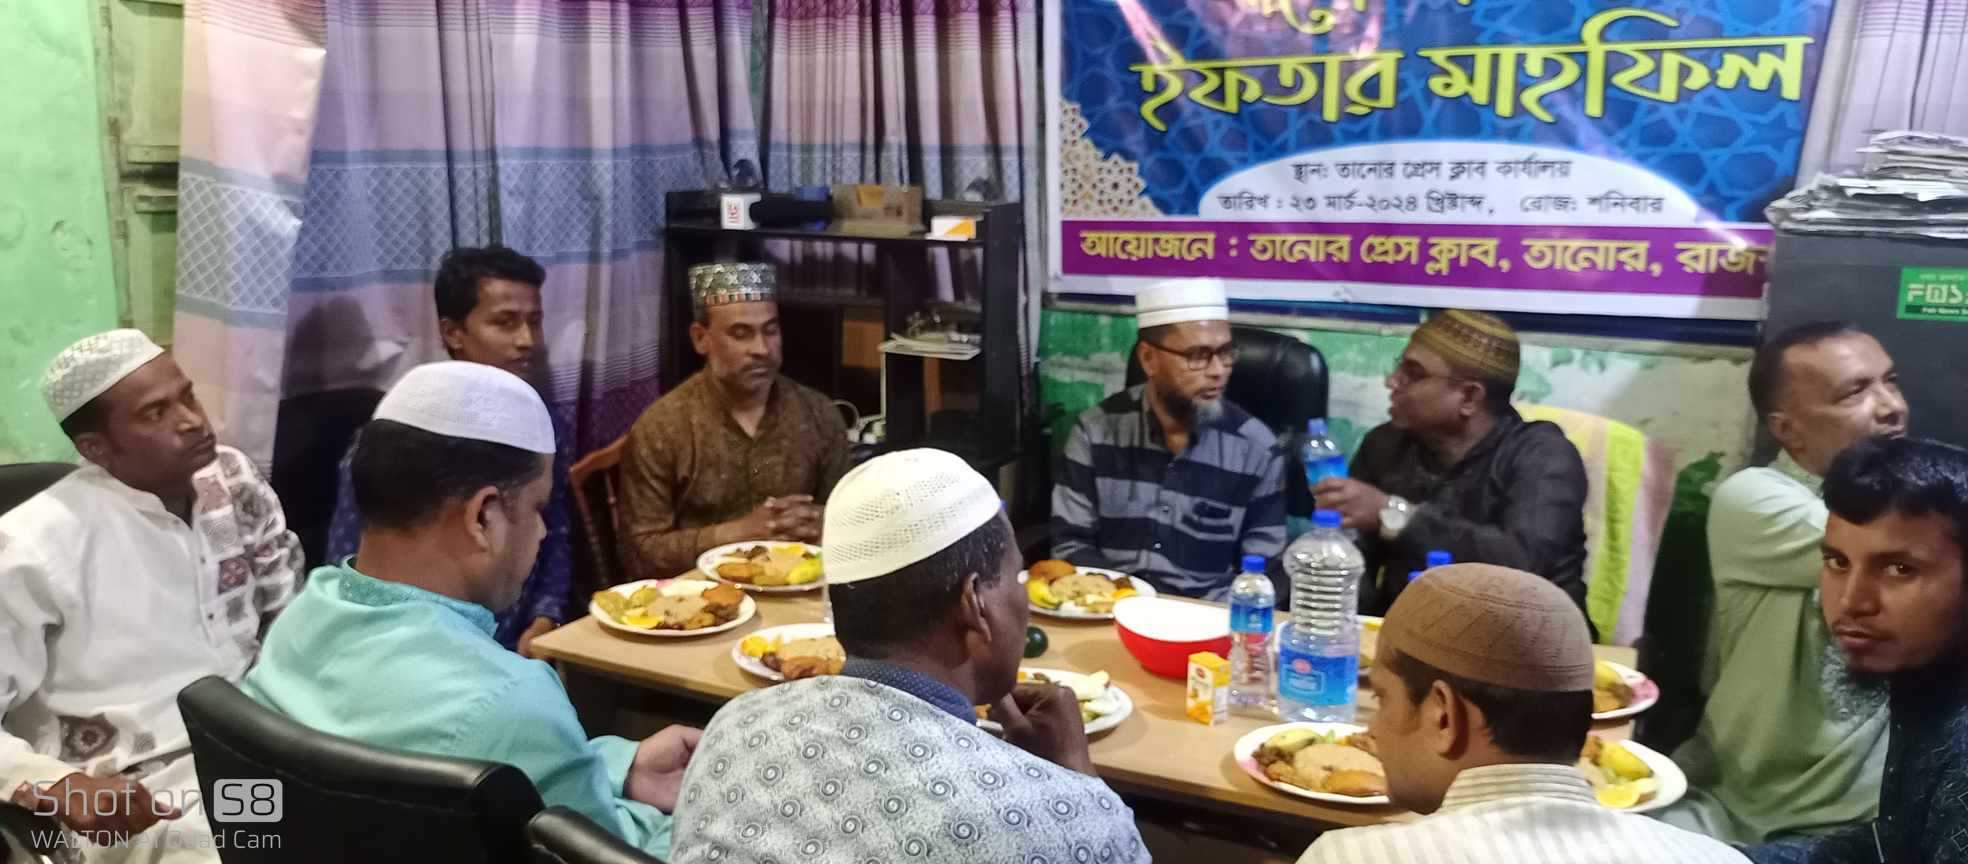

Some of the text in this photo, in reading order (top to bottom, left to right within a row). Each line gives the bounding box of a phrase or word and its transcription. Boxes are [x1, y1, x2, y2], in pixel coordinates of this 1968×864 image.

[1129, 8, 1814, 132] ইফতার মাহফিল
[1336, 161, 1396, 181] তানোর
[1402, 161, 1441, 181] প্রেস
[1449, 160, 1487, 181] ক্লাব
[1494, 152, 1573, 180] কার্যালয়
[1217, 189, 1270, 211] তারিখ
[1290, 195, 1316, 212] ২৩
[1586, 189, 1664, 213] শনিবার
[1079, 230, 1215, 261] আয়োজনে
[1249, 232, 1351, 263] তানোর
[1360, 234, 1420, 264] প্রেস
[1426, 236, 1511, 276] ক্লাব,
[1521, 237, 1662, 278] তানোর,
[1675, 240, 1775, 275] রাজ
